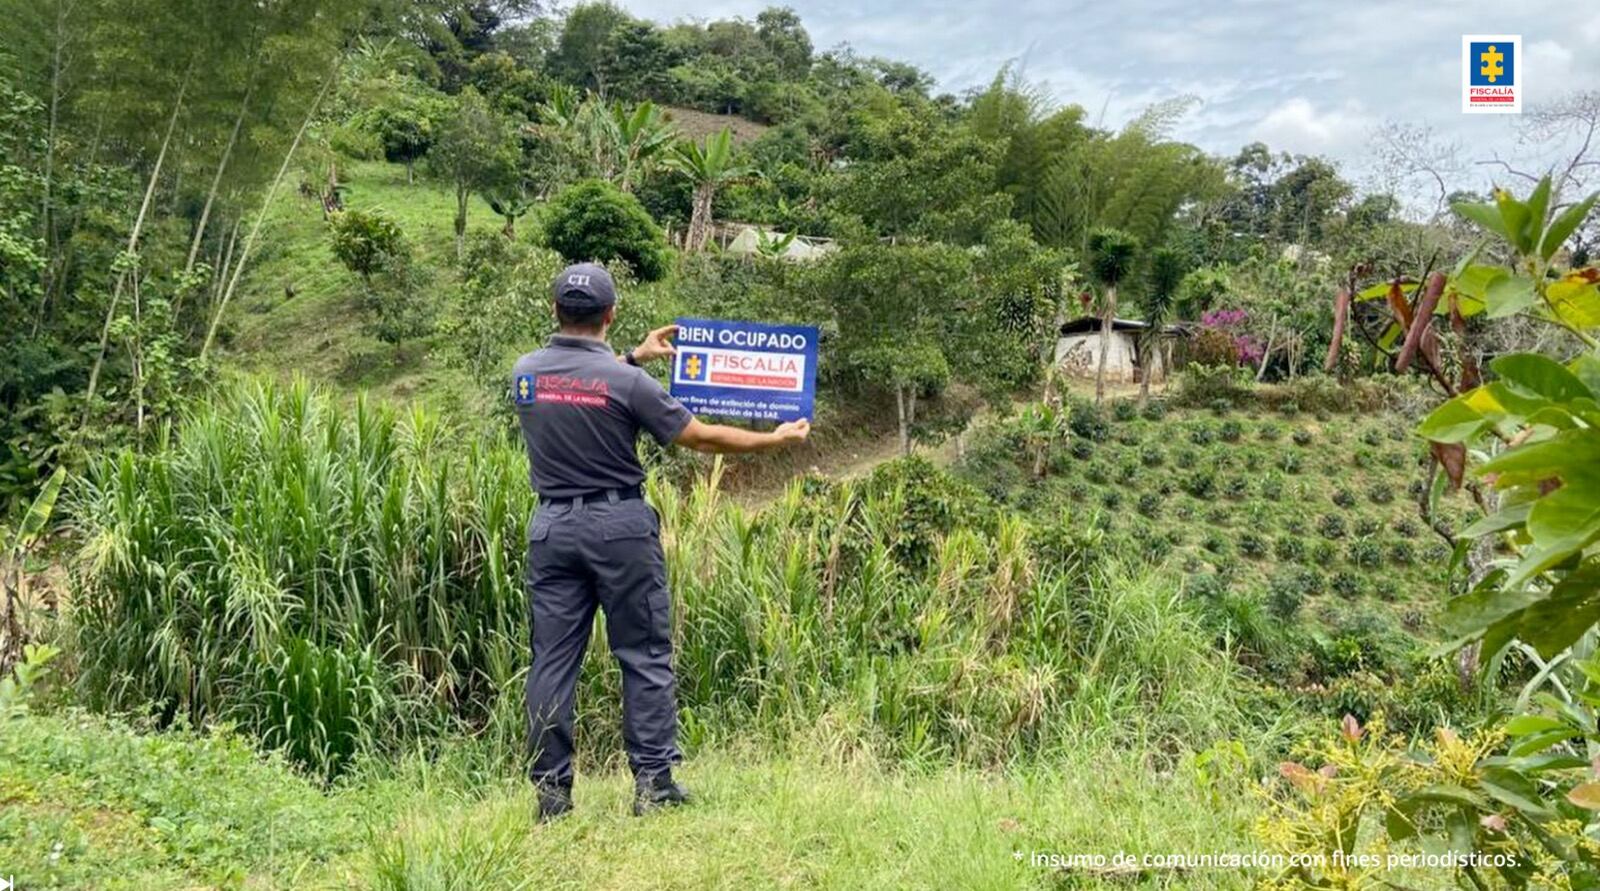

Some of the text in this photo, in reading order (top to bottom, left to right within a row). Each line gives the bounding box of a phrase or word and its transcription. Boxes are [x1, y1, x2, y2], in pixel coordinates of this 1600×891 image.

[568, 274, 590, 286] CTI
[678, 326, 807, 350] BIEN OCUPADO
[711, 354, 798, 373] FISCALÍA
[709, 398, 719, 406] de
[757, 401, 767, 409] de
[743, 409, 753, 417] de
[754, 410, 762, 418] la
